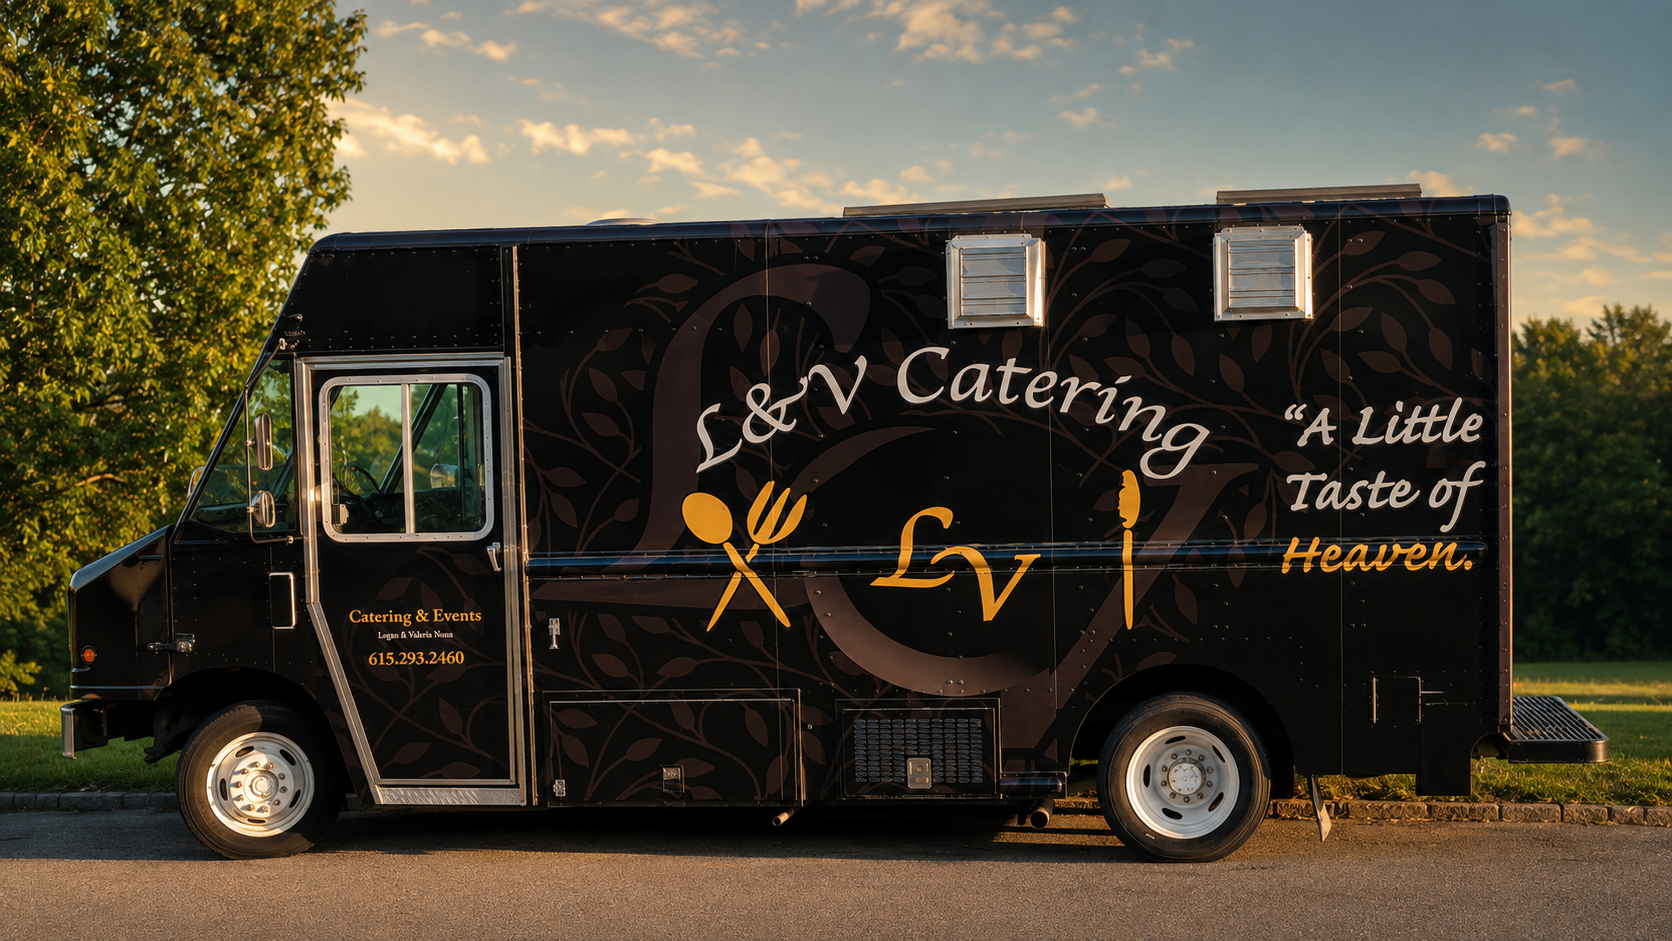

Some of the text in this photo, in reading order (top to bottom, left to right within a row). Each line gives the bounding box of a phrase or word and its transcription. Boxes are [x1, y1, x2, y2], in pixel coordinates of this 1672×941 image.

[897, 346, 1211, 480] Catering
[1351, 397, 1484, 445] Little
[1286, 460, 1487, 533] Taste of
[1281, 536, 1473, 575] Heaven.
[348, 608, 482, 627] Catering & Events
[368, 651, 465, 666] 615.293.2460
